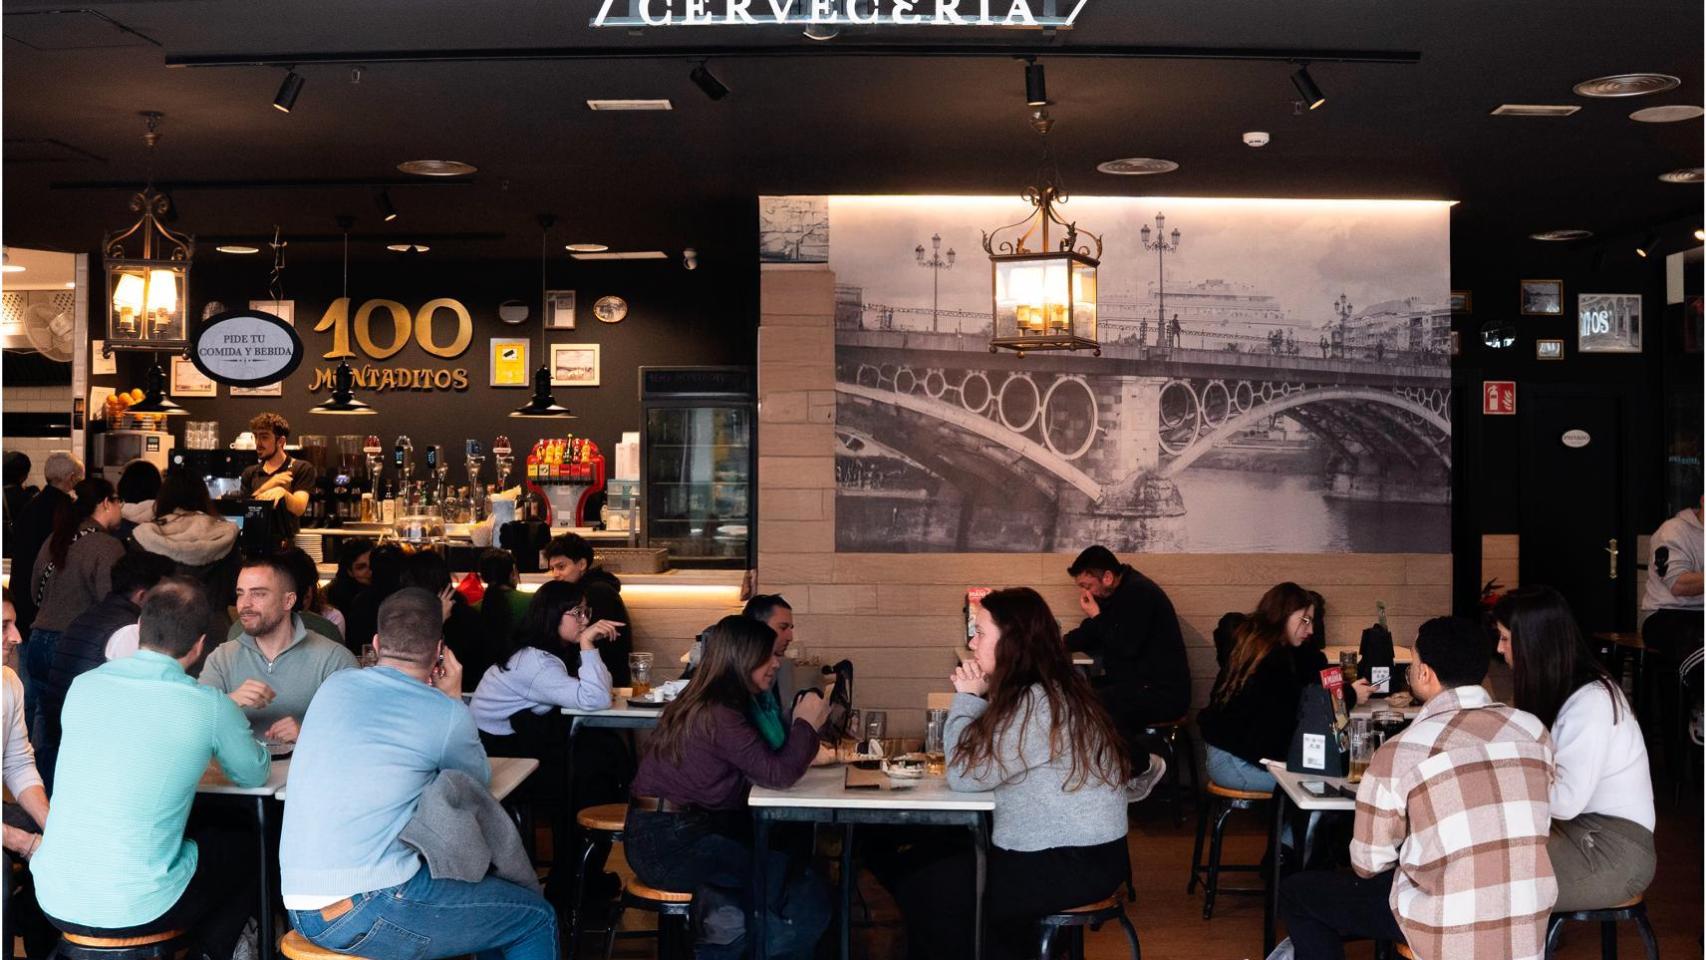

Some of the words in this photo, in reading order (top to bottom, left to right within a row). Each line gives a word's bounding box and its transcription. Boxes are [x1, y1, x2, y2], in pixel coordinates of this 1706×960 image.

[638, 0, 1039, 25] CERVECERIA
[223, 334, 248, 343] PIDE
[250, 334, 265, 343] TU
[313, 297, 473, 359] 100
[199, 347, 242, 357] COMIDA
[244, 347, 252, 356] Y
[254, 346, 292, 356] BEBIDA
[308, 364, 468, 391] MNTADITOS
